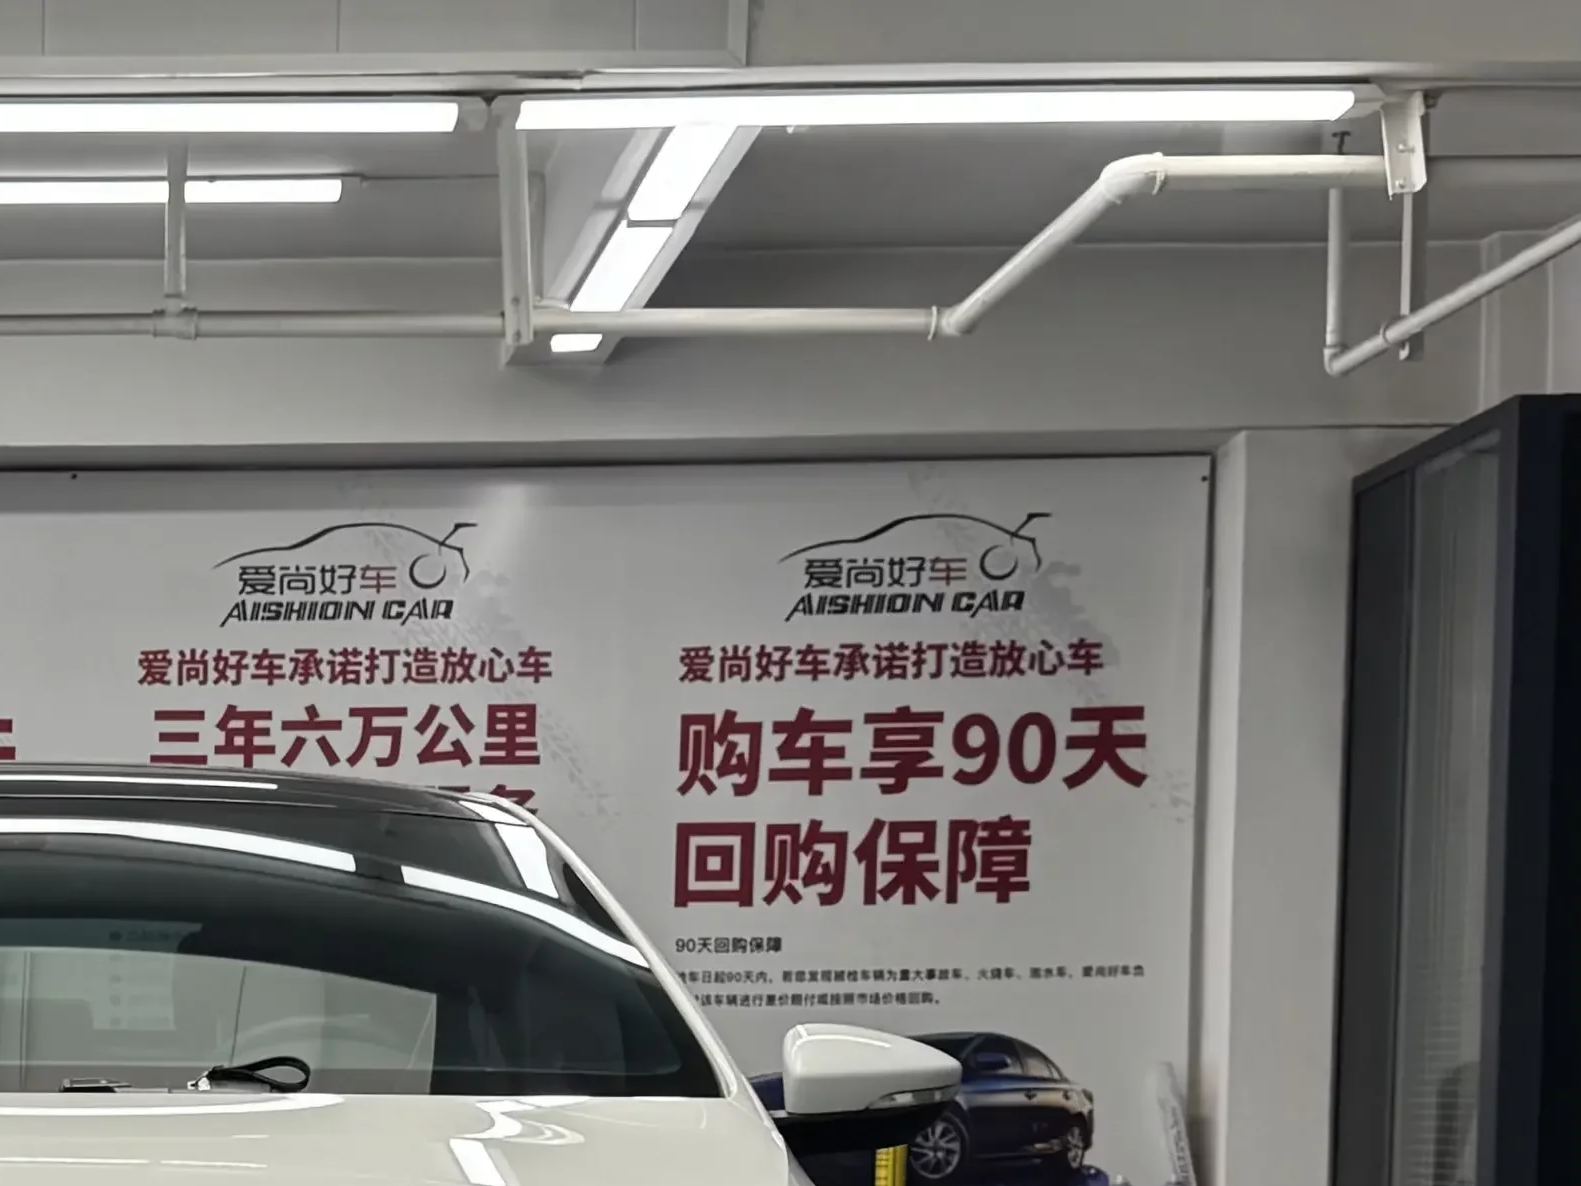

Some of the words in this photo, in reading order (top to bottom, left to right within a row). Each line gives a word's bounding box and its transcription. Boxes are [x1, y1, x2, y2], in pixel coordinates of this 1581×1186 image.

[238, 564, 397, 596] 爱尚好车
[804, 556, 968, 589] 爱尚好车
[219, 599, 375, 628] AISHION
[381, 597, 454, 627] CAR
[784, 591, 946, 623] AISHION
[950, 588, 1026, 619] CAR
[137, 645, 553, 687] 爱尚好车承诺打造放心车
[678, 636, 1106, 684] 爱尚好车承诺打造放心车
[149, 703, 541, 769] 三年六万公里
[676, 704, 1149, 797] 购车享90天
[673, 813, 1033, 909] 回购保障
[675, 936, 783, 954] 90天回购保障
